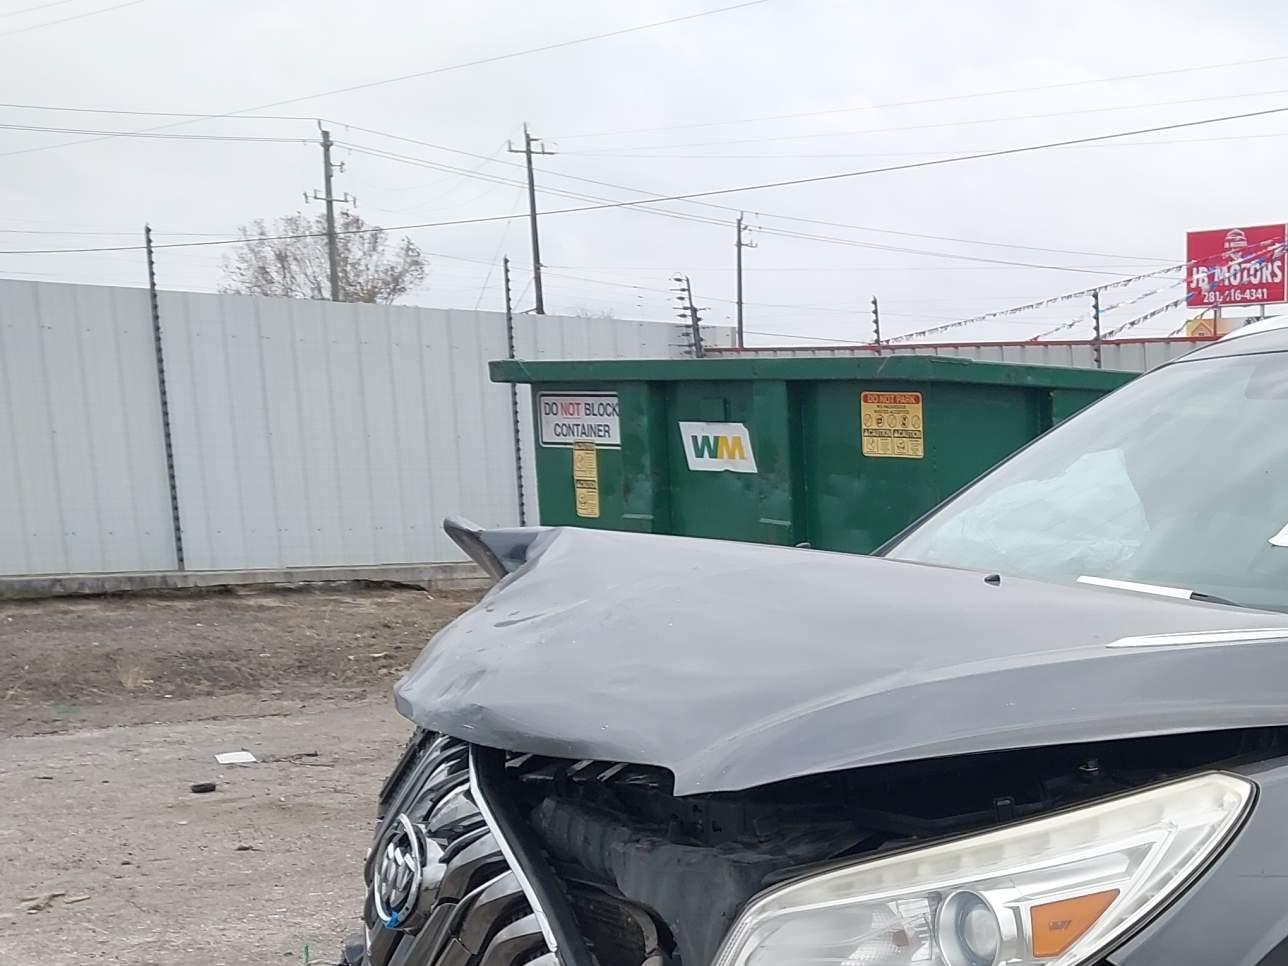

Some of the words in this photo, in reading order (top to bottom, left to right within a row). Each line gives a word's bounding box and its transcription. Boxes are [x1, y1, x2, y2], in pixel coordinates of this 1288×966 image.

[1190, 266, 1209, 288] JB
[1214, 260, 1283, 286] MOTORS
[543, 402, 559, 416] DO
[561, 402, 581, 417] NOT
[584, 403, 620, 417] BLOCK
[553, 423, 611, 438] CONTAINER
[691, 435, 746, 460] WM
